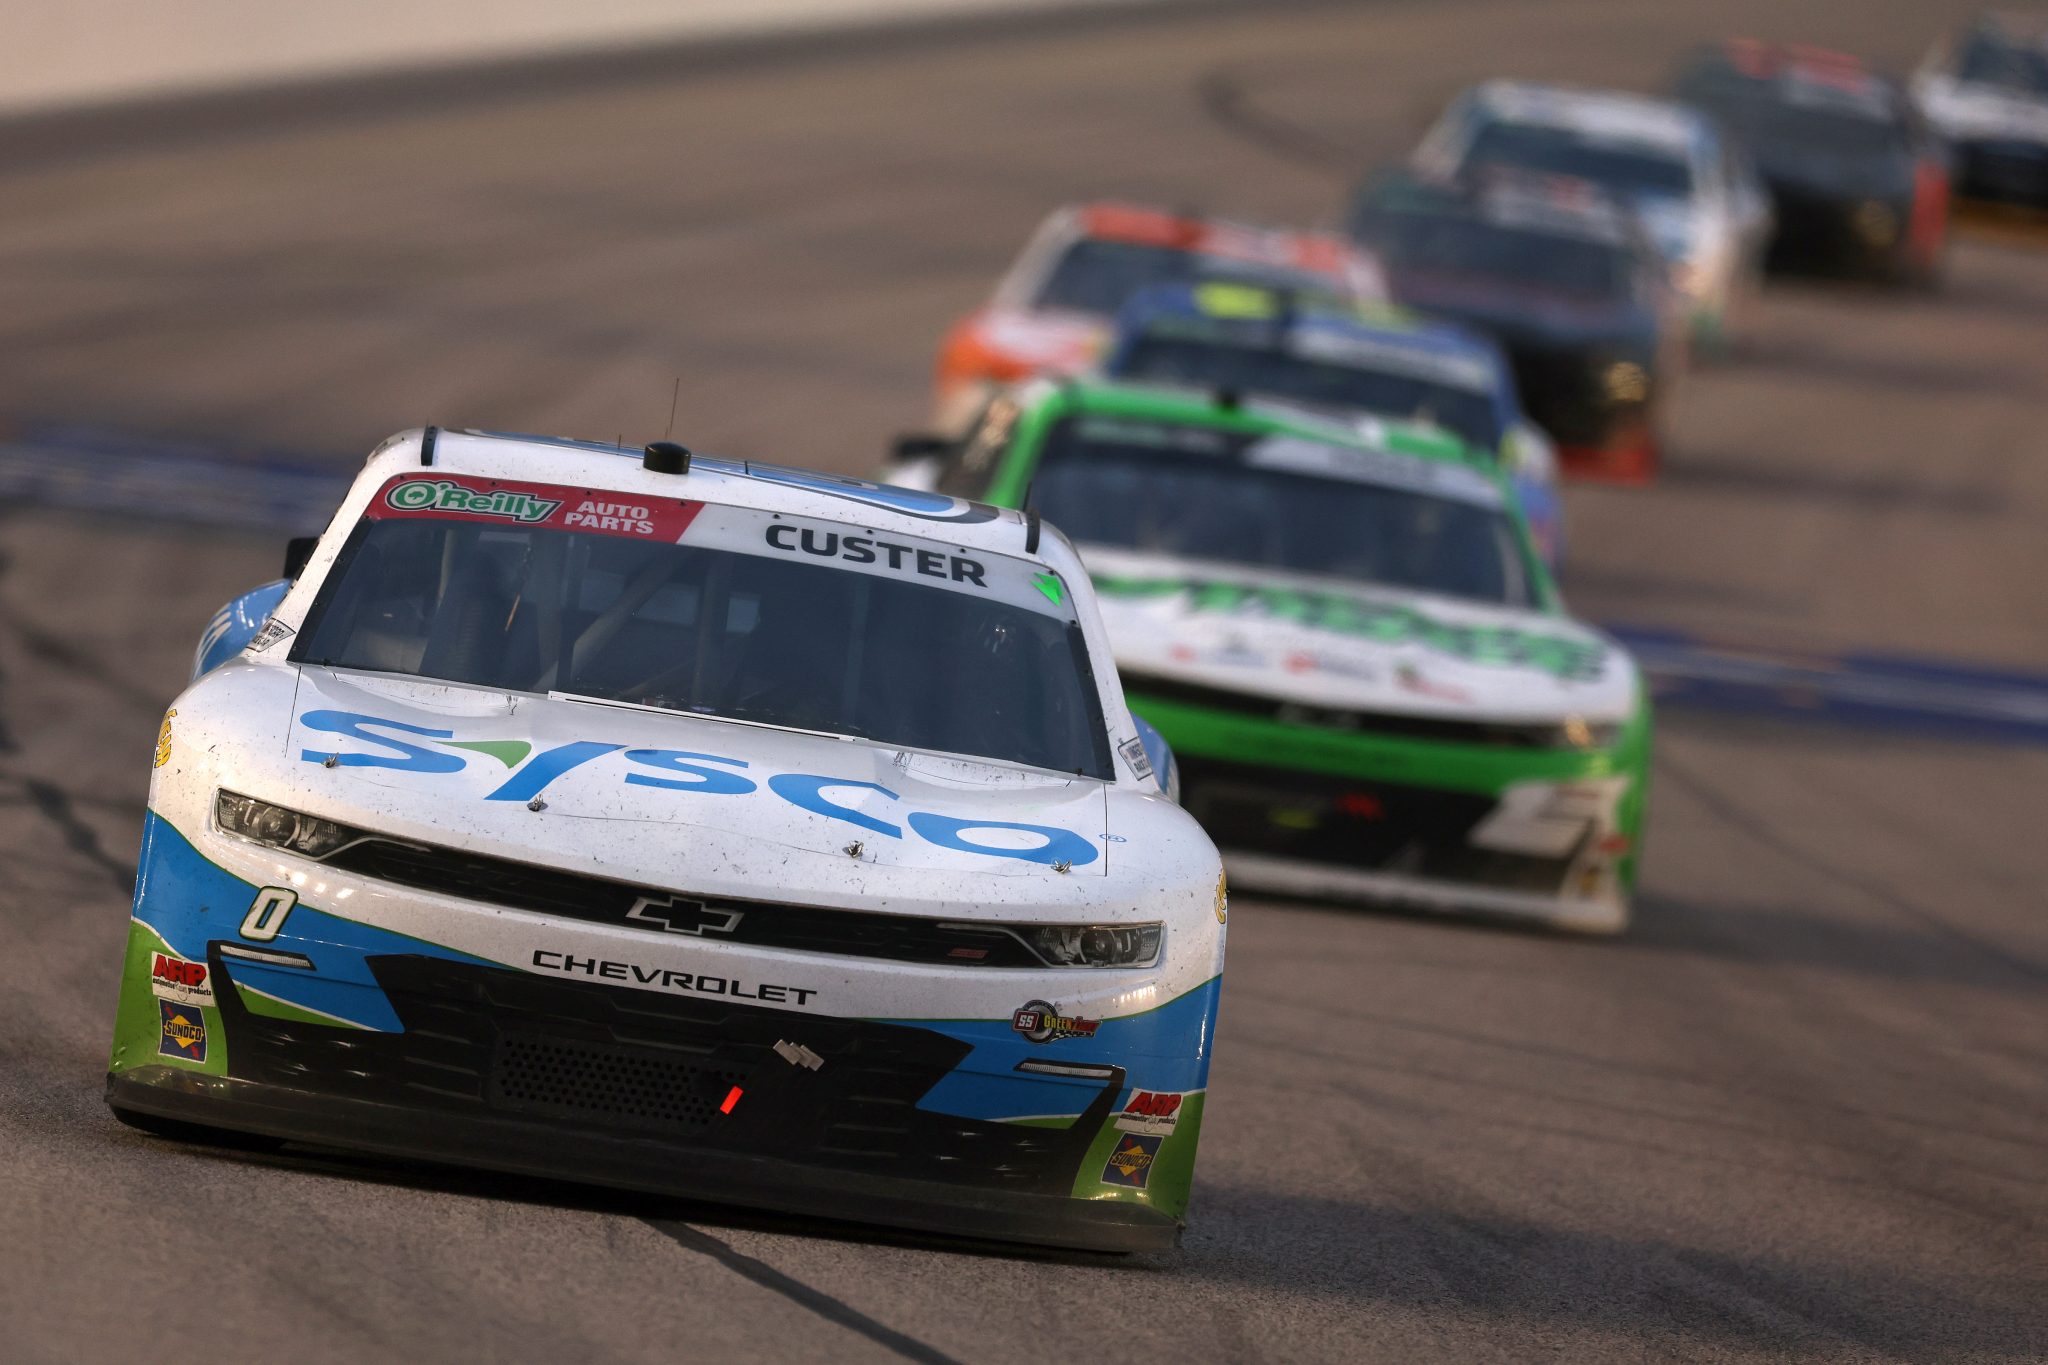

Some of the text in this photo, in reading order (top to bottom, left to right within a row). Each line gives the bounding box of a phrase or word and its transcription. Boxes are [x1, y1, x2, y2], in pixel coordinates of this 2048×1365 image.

[392, 482, 553, 520] O'Reilly
[577, 500, 650, 520] AUTO
[564, 512, 654, 535] PARTS
[765, 524, 988, 588] CUSTER
[239, 885, 299, 943] 0
[153, 953, 207, 987] ARP
[532, 949, 817, 1006] CHEVROLET
[166, 1020, 202, 1041] SUNOCO
[1123, 1091, 1182, 1117] ARP
[1111, 1152, 1151, 1169] SUNOCO
